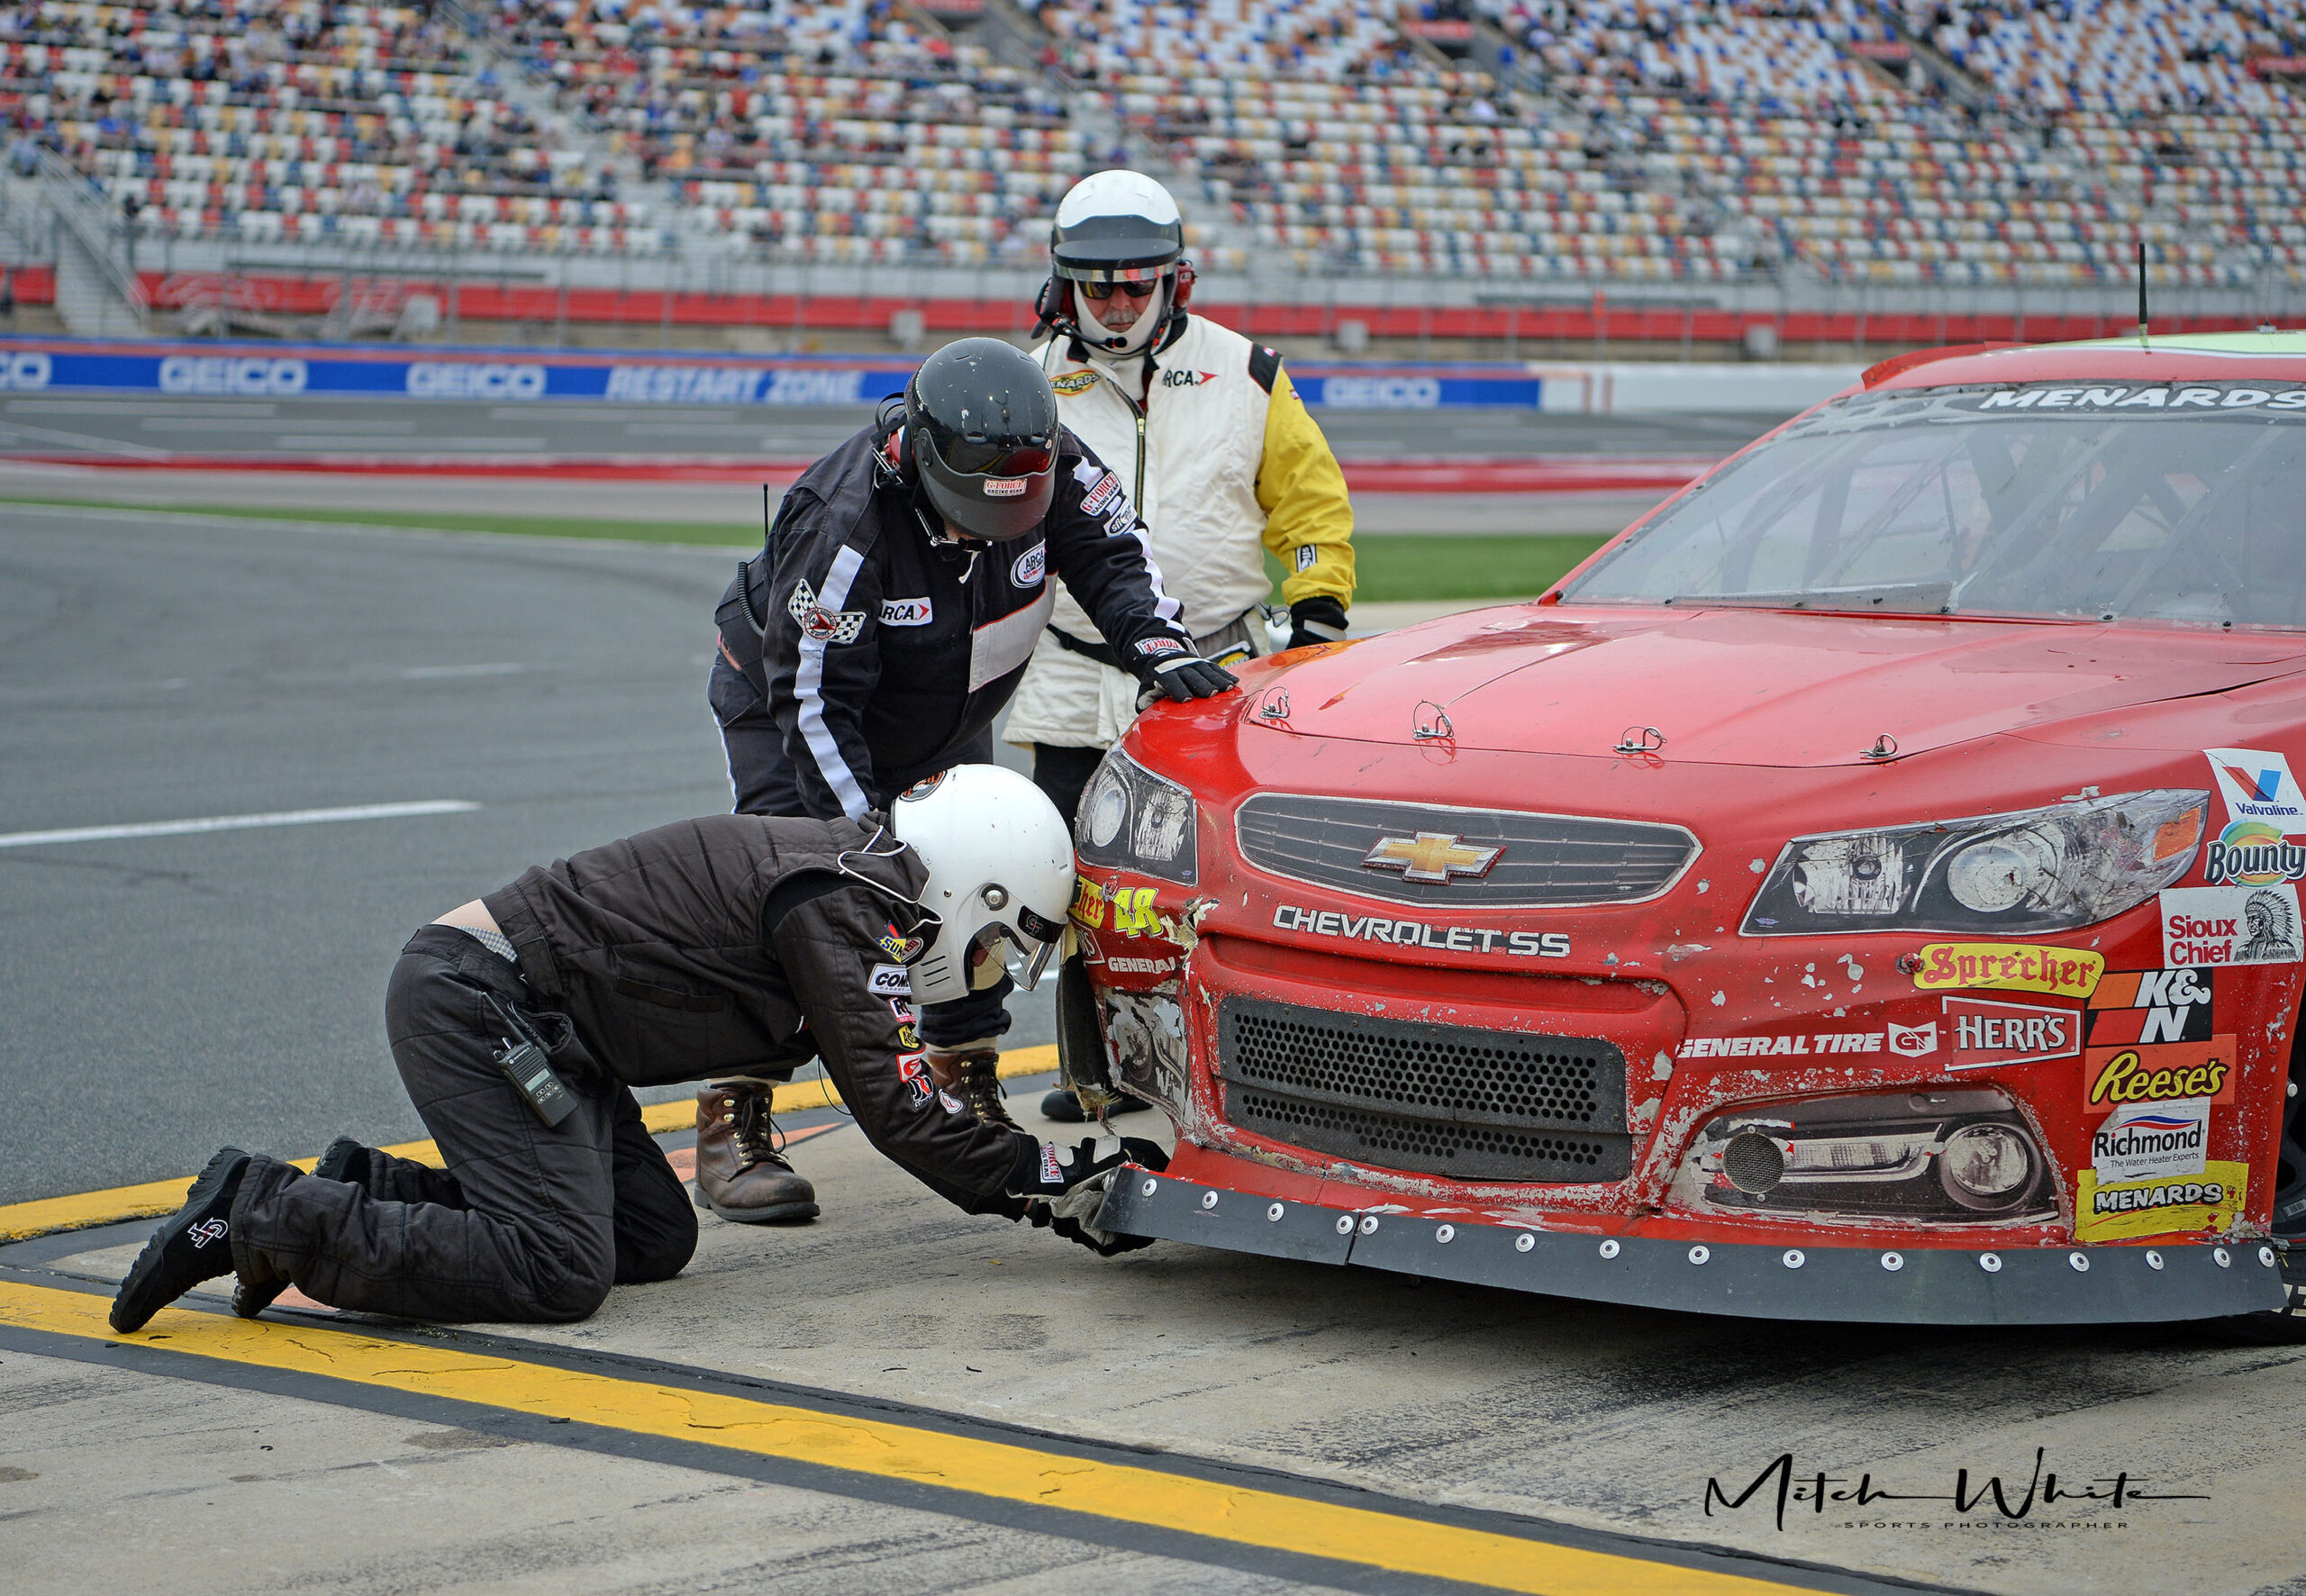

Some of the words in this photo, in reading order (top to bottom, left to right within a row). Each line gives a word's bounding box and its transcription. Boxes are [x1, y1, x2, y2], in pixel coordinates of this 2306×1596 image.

[159, 356, 308, 395] GEICO
[405, 362, 546, 399] GEICO
[605, 366, 764, 403] RESTART
[764, 369, 866, 404] ZONE
[1322, 376, 1440, 408] GEICO
[1980, 386, 2306, 411] MENARDS
[1091, 494, 1110, 514] RACING
[1108, 483, 1120, 497] GEAR
[2236, 802, 2298, 816] Valvoline
[2206, 840, 2306, 886] Bounty
[1272, 904, 1503, 954] CHEVROLET
[1508, 930, 1572, 958] SS
[2169, 914, 2238, 939] Sioux
[1923, 946, 2094, 991] Sprecher
[2169, 939, 2232, 965] Chief
[1679, 1036, 1813, 1059] GENERAL
[1812, 1032, 1884, 1054] TIRE
[1954, 1014, 2066, 1053] HERR'S
[2090, 1050, 2230, 1105] Reese's
[2093, 1119, 2202, 1158] Richmond
[2110, 1158, 2124, 1169] The
[2125, 1156, 2147, 1168] Water
[2148, 1153, 2172, 1165] Heater
[2173, 1151, 2200, 1165] Experts
[2094, 1183, 2223, 1214] MENARDS
